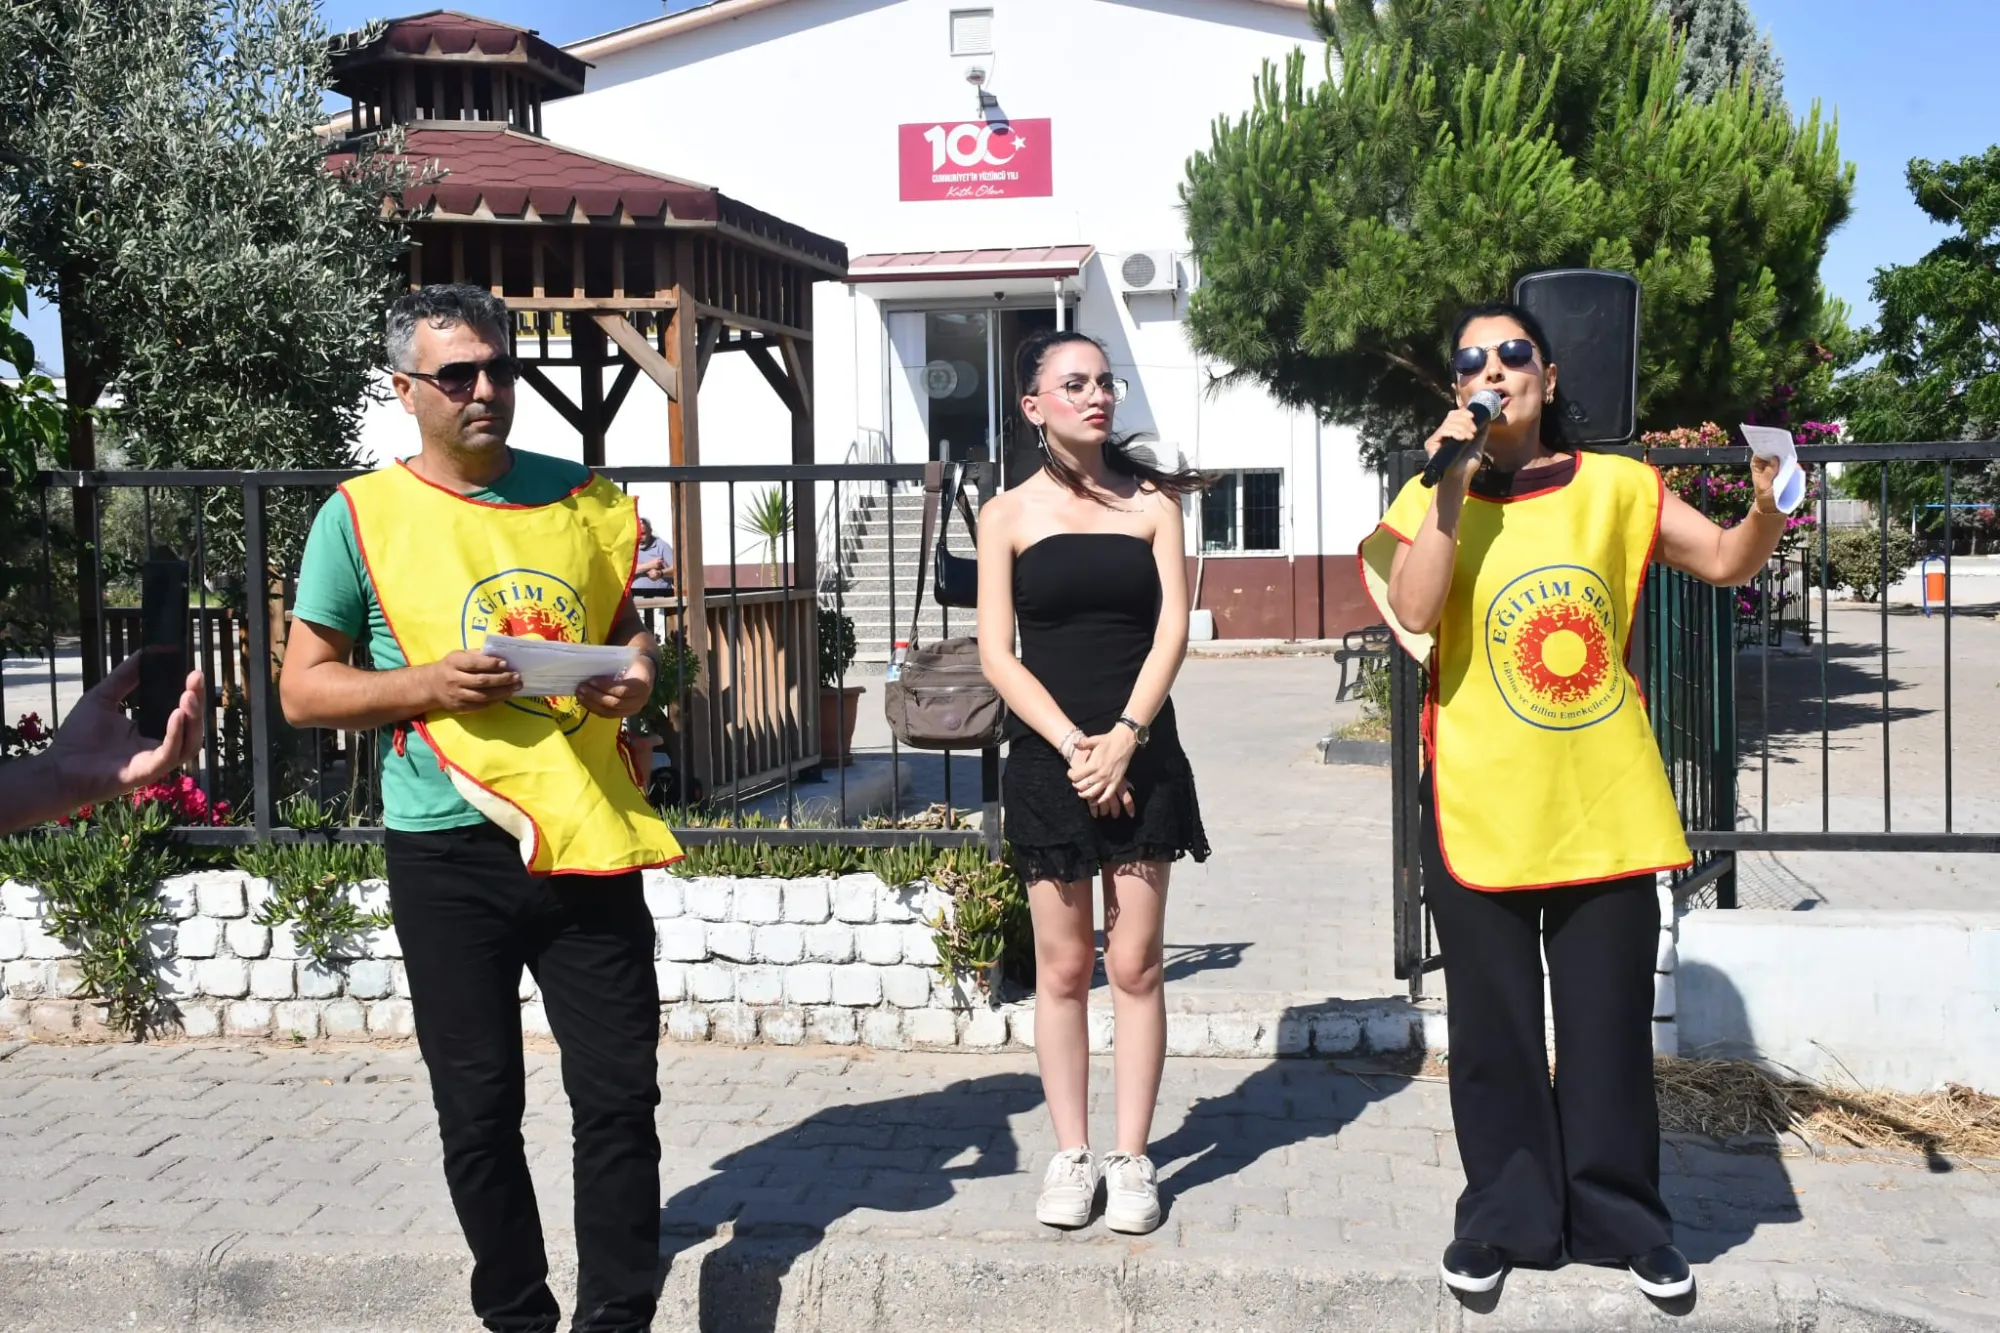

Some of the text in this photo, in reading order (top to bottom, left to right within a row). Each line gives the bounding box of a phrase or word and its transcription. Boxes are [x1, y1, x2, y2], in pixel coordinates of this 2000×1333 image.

[923, 123, 1016, 172] 100
[1493, 581, 1611, 645] EĞİTİM SEN
[1530, 703, 1557, 718] Bilim
